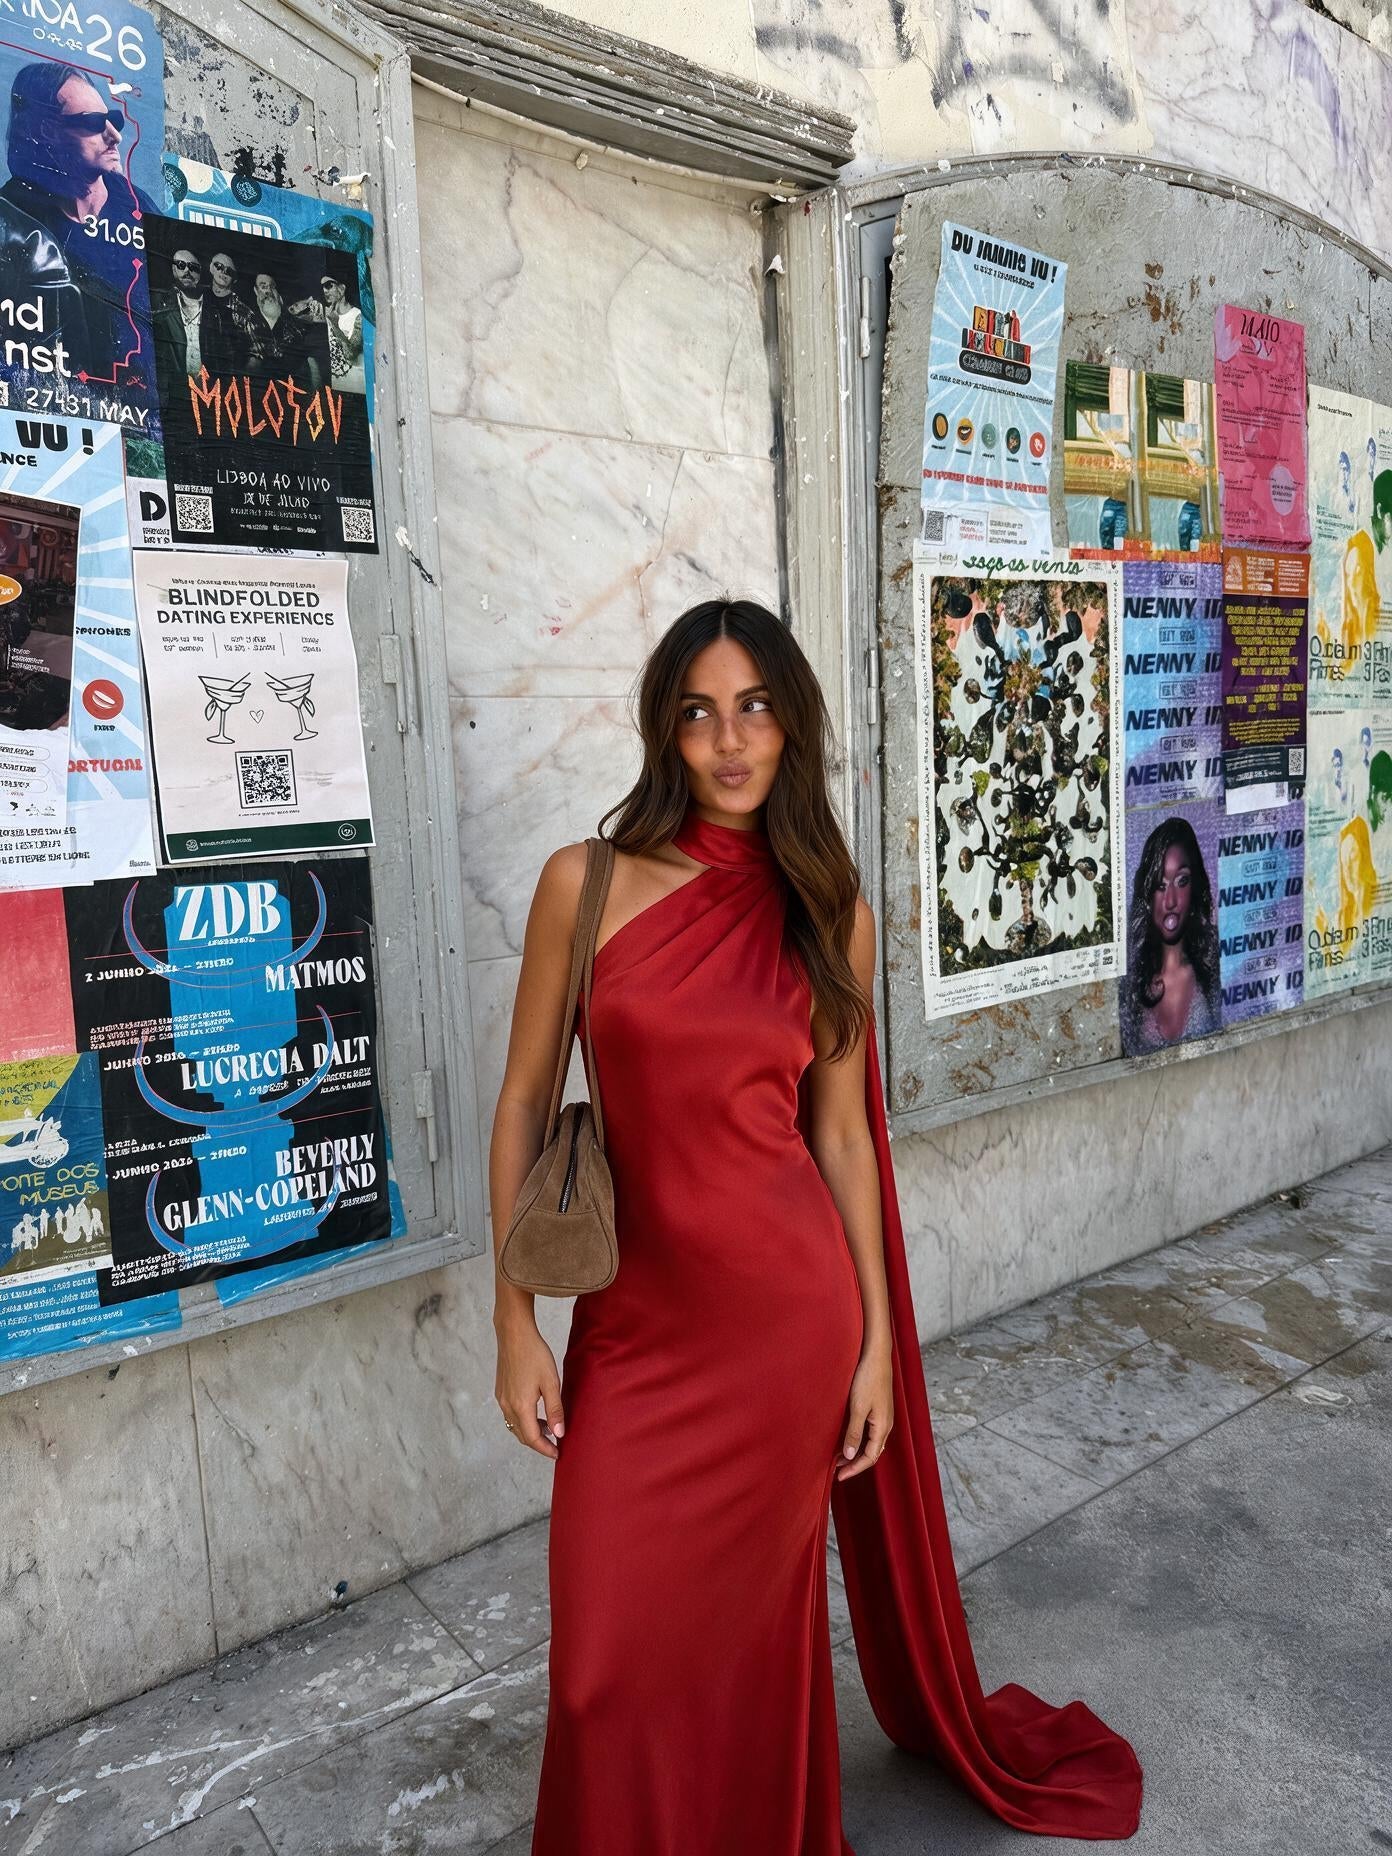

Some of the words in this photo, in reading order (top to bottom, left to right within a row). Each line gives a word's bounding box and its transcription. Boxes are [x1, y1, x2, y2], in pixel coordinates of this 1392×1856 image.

[84, 214, 146, 250] 31.05
[951, 229, 973, 254] DU
[99, 400, 149, 427] MAY
[188, 364, 343, 447] MOLOTOV
[168, 588, 320, 608] BLINDFOLDED
[1123, 597, 1198, 619] NENNY
[157, 610, 226, 625] DATING
[1124, 653, 1196, 675] NENNY
[1126, 706, 1198, 731] NENNY
[1126, 759, 1197, 788] NENNY
[1218, 832, 1278, 858] NENNY
[1218, 880, 1277, 908] NENNY
[176, 882, 281, 941] ZDB
[1219, 928, 1278, 958] NENNY
[265, 956, 367, 993] MATMOS
[1220, 975, 1280, 1006] NENNY
[181, 1046, 304, 1091] LUCRECIA
[313, 1035, 370, 1069] DALT
[275, 1133, 374, 1177] BEVERLY
